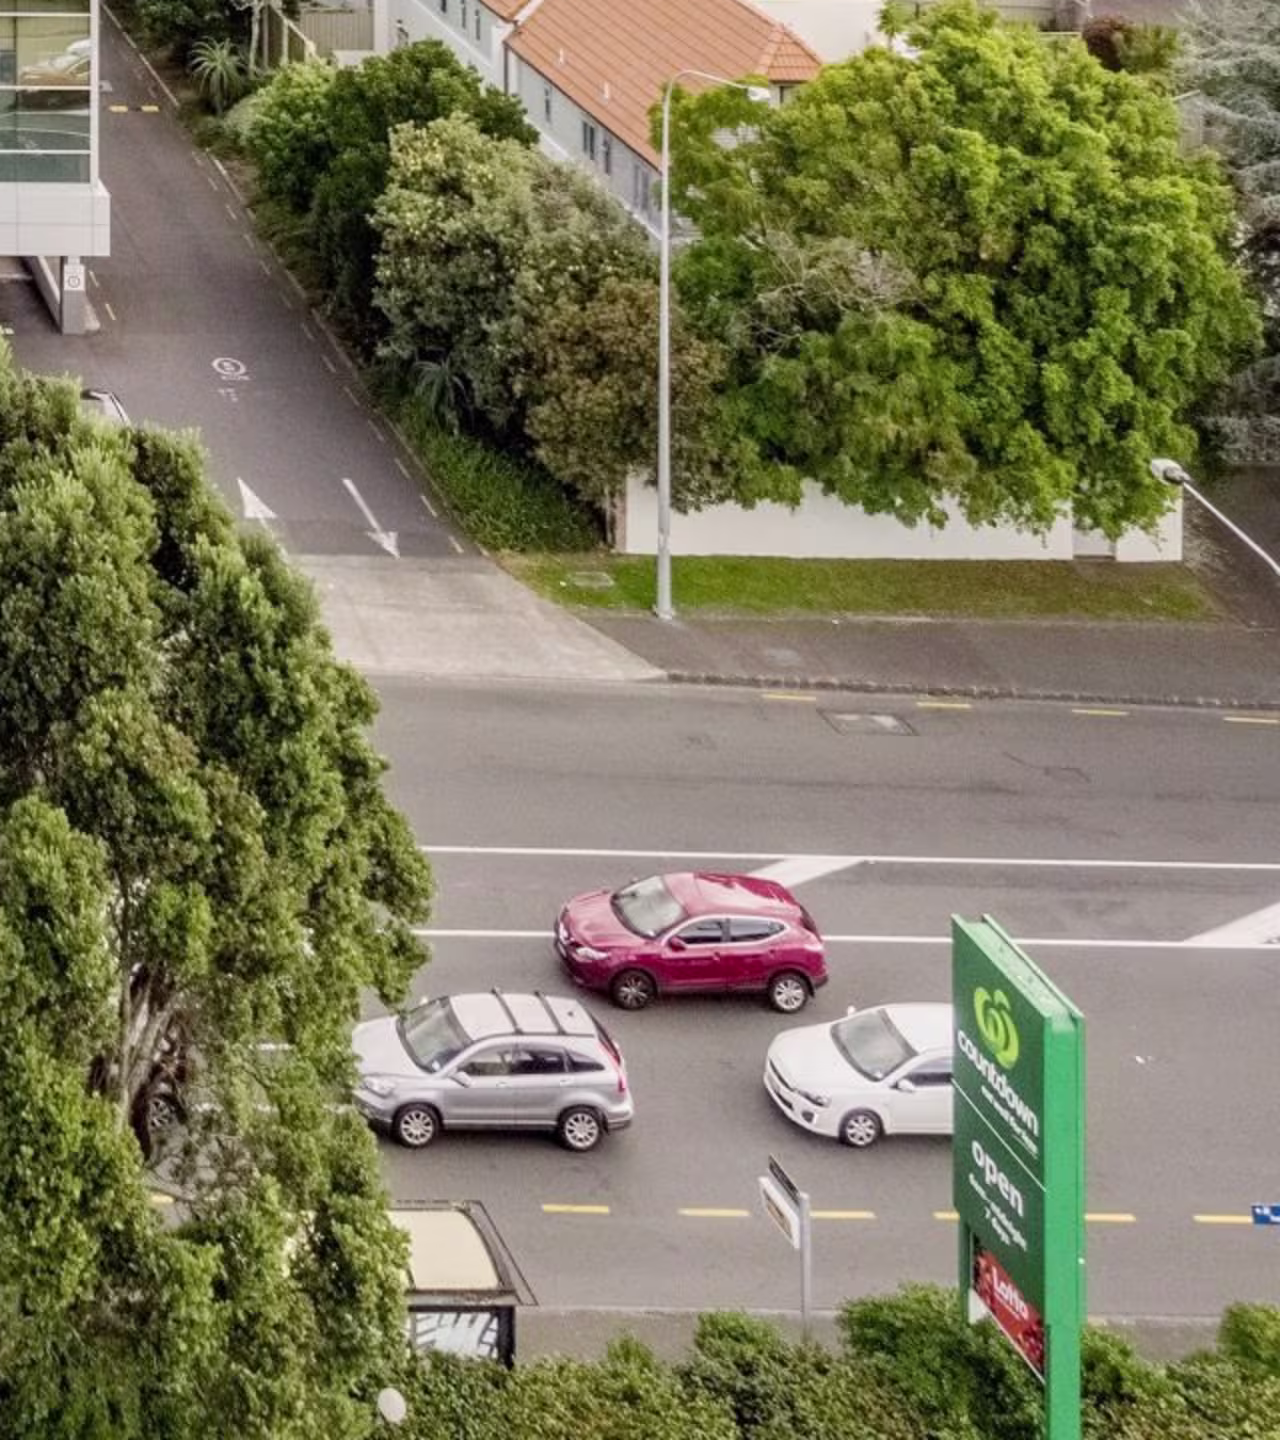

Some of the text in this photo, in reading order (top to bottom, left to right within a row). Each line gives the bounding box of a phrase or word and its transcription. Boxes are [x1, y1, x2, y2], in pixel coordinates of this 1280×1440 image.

[958, 1029, 1039, 1138] countdown
[972, 1140, 1024, 1218] open
[992, 1264, 1029, 1321] Lotto
